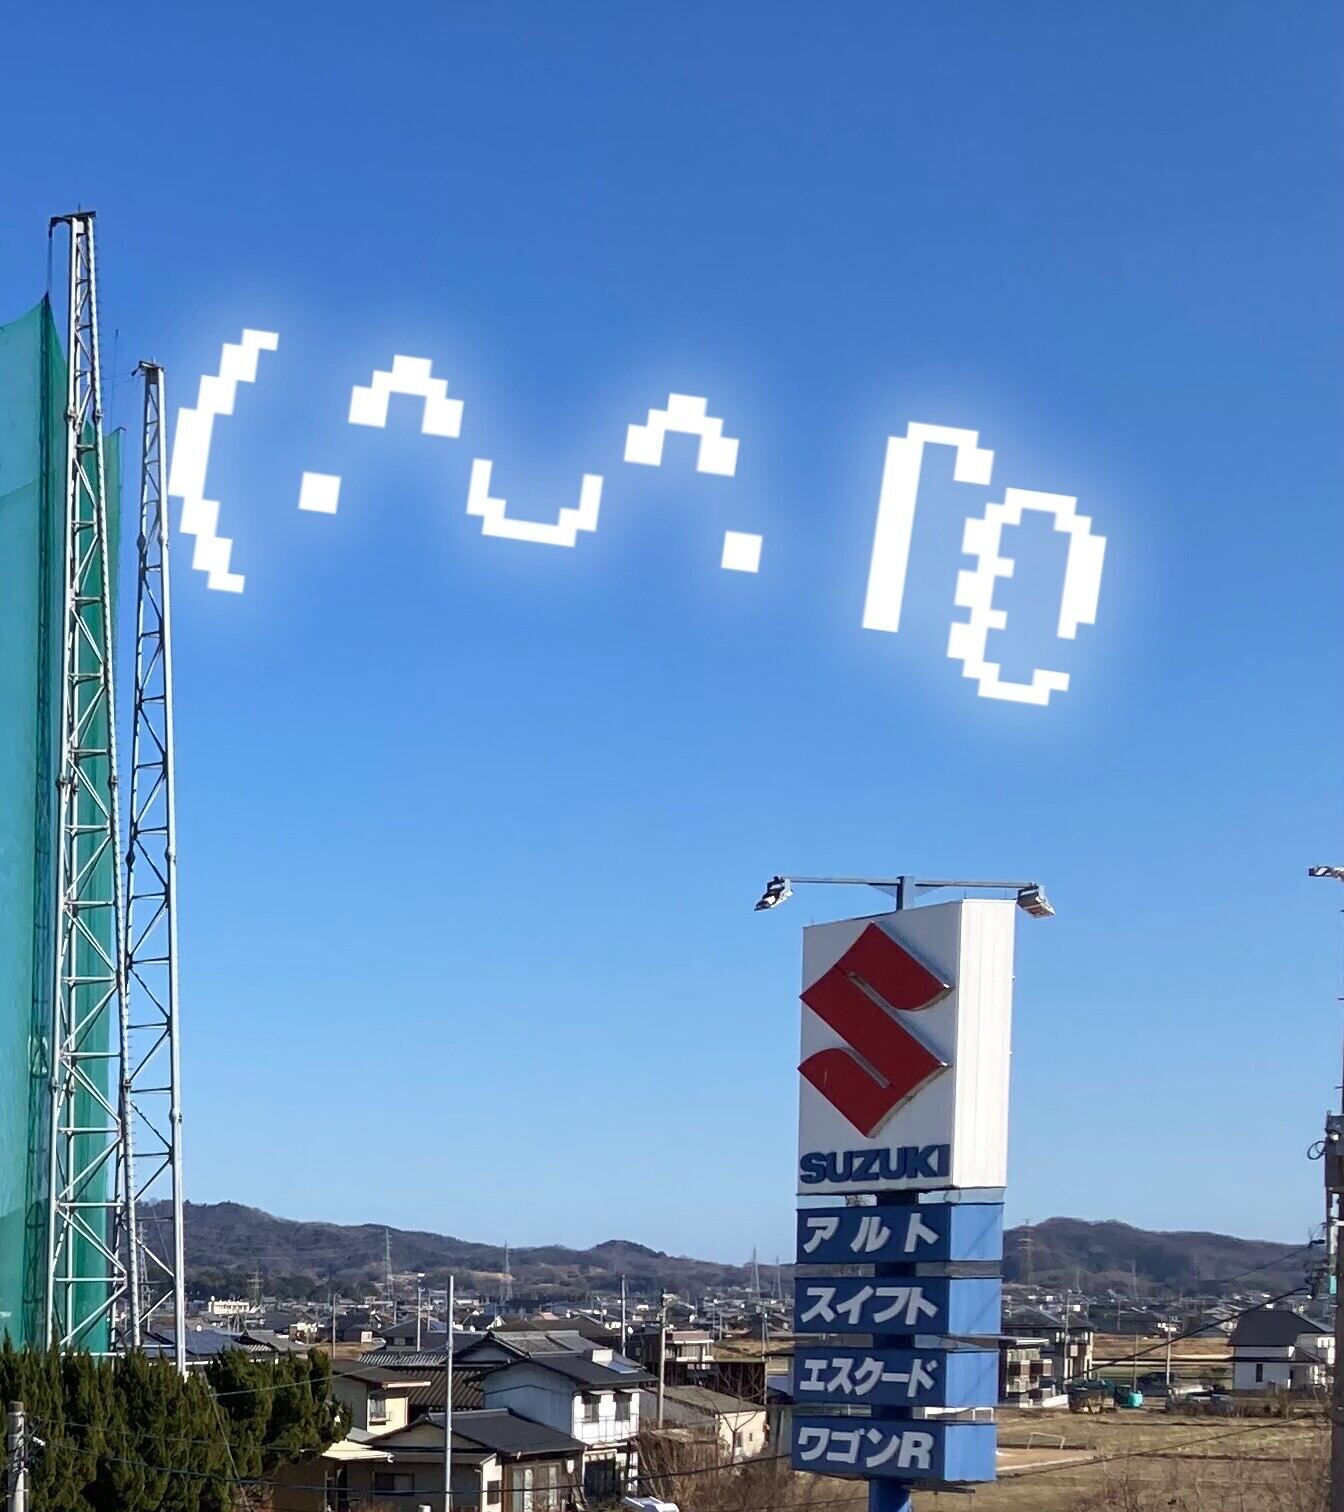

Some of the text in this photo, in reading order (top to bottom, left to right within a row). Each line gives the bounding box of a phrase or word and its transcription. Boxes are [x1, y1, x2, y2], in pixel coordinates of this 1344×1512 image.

[799, 1144, 950, 1184] SUZUKI
[803, 1213, 939, 1255] アルト
[799, 1286, 939, 1325] スイフト
[798, 1356, 937, 1397] エスクード
[797, 1427, 935, 1470] ワゴンR
